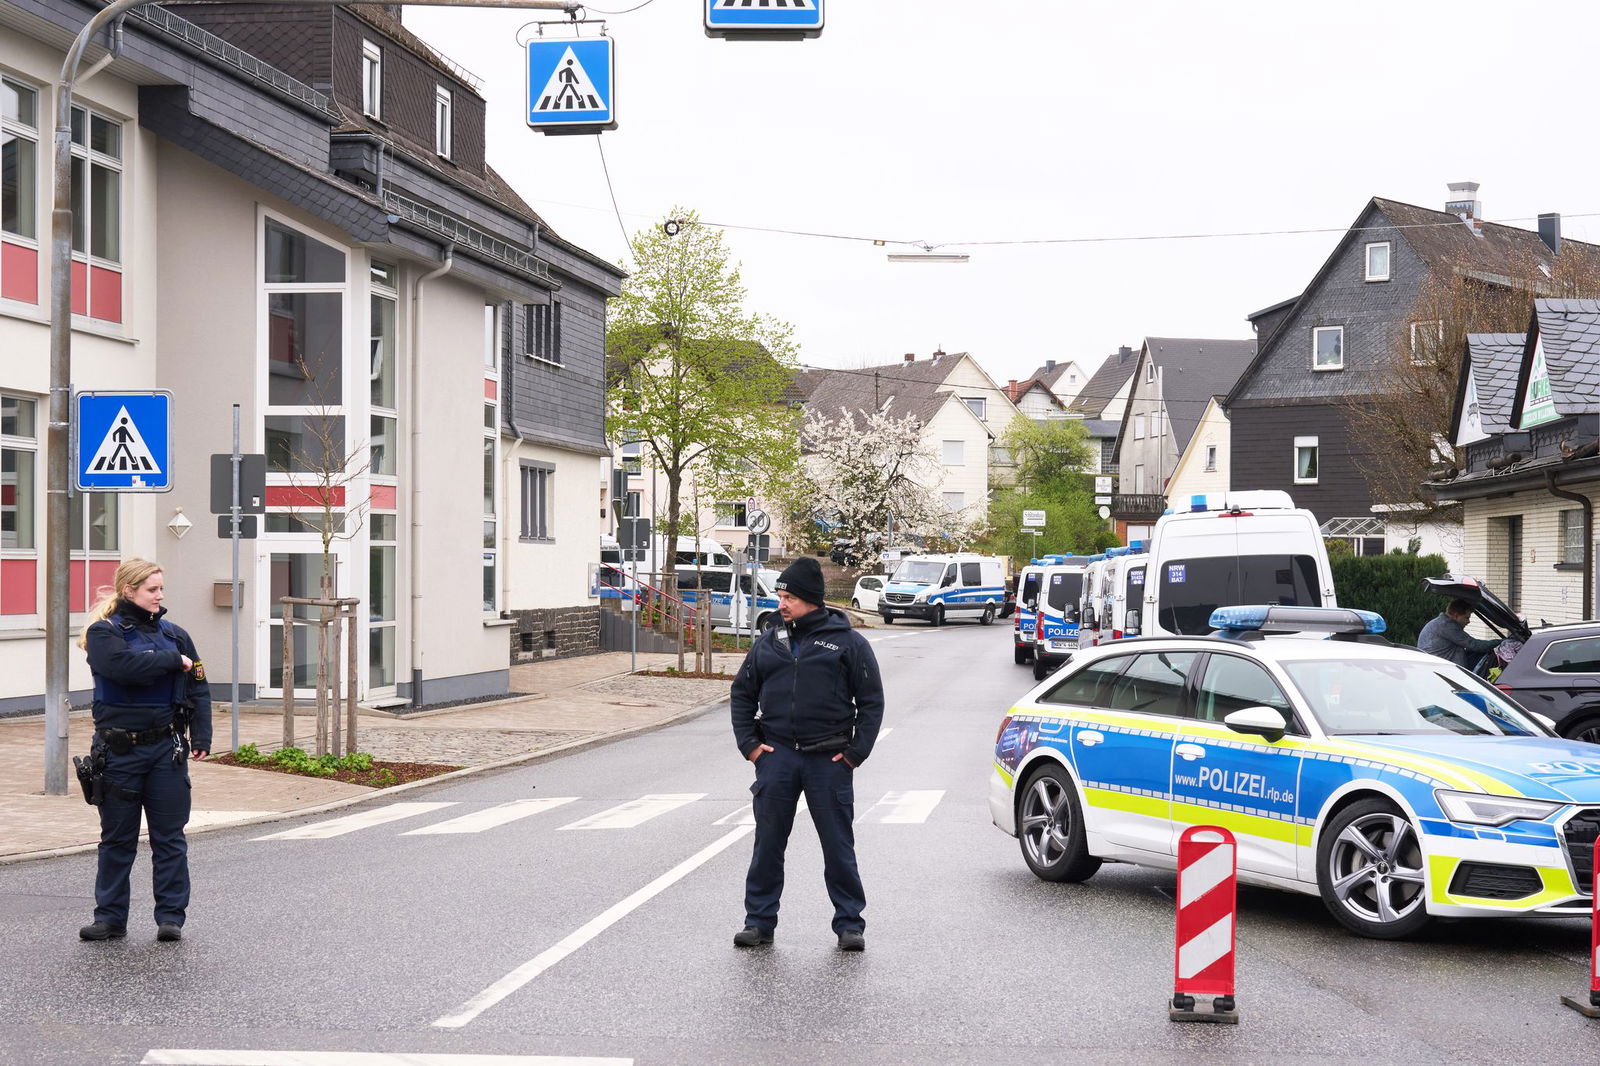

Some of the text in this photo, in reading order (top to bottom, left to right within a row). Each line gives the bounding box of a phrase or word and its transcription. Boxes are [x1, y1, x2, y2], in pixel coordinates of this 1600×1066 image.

[750, 515, 765, 527] 30
[814, 640, 839, 651] POLIZEI
[1174, 766, 1294, 804] www.POLIZEI.rlp.de
